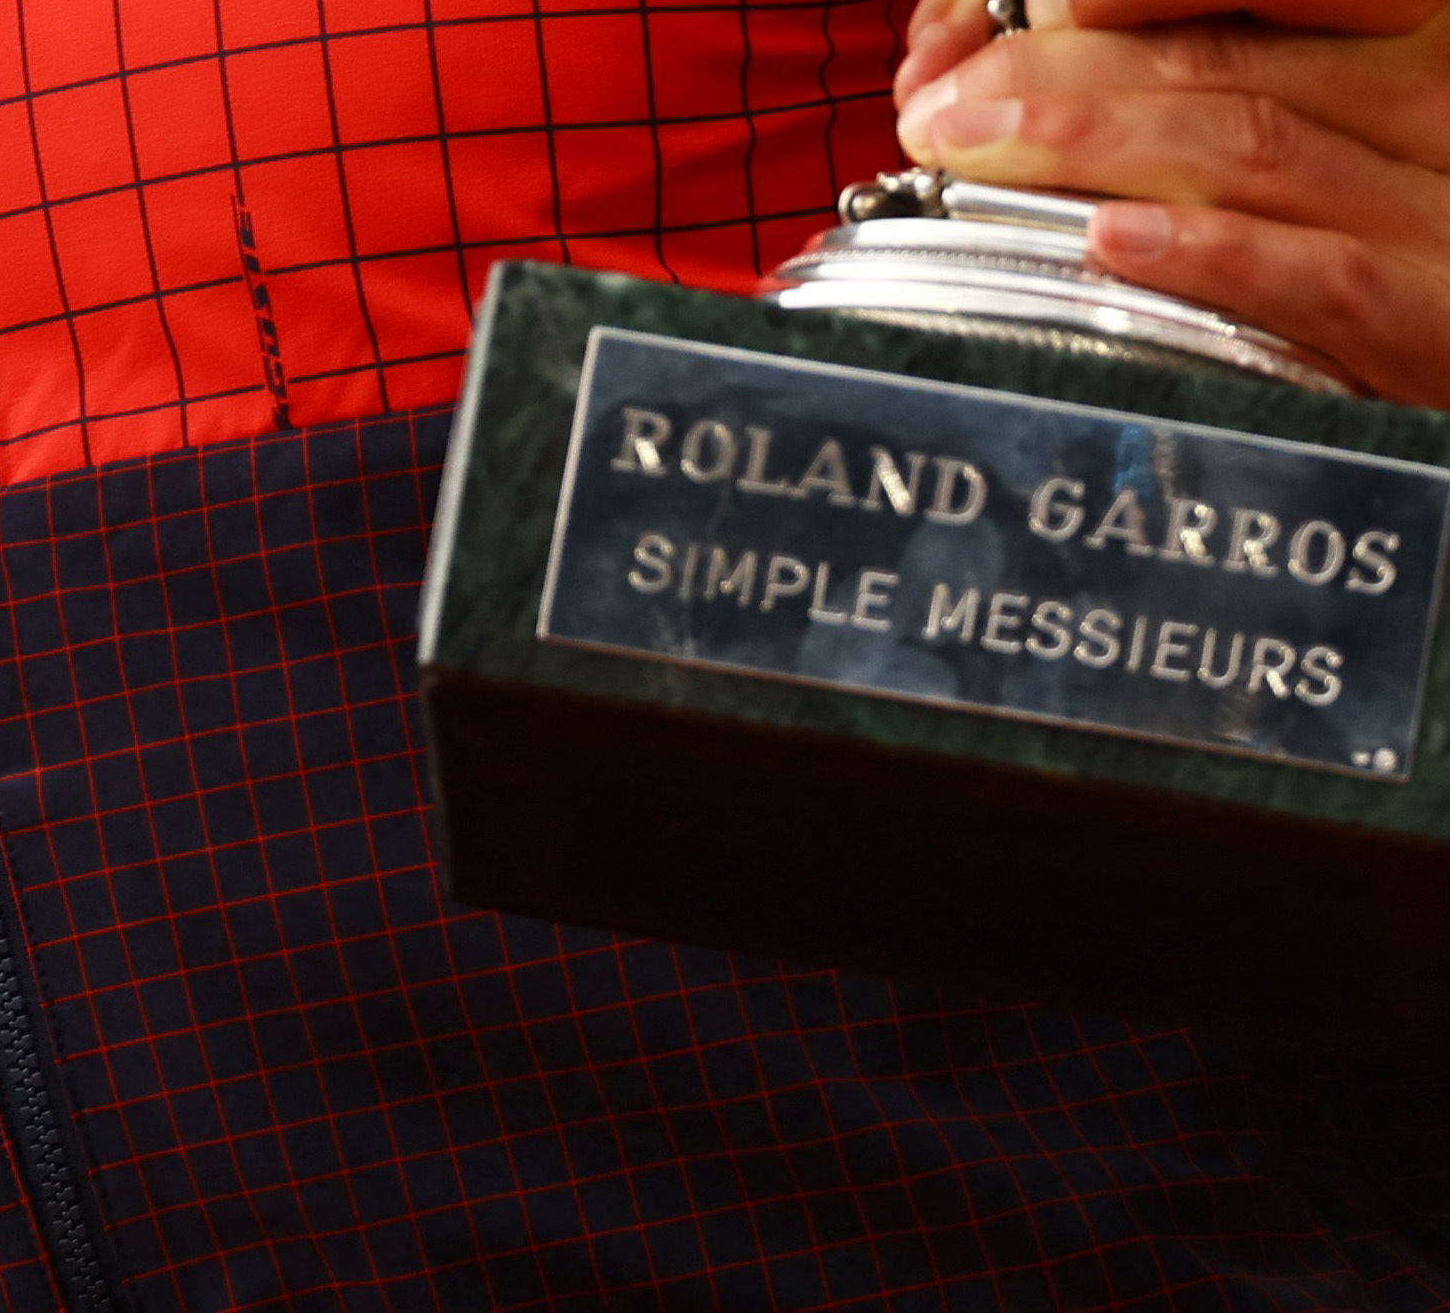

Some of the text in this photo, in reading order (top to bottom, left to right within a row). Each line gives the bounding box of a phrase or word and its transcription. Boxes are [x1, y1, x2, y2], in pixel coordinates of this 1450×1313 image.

[610, 405, 1400, 596] ROLAND GARROS
[627, 529, 1345, 708] SIMPLE MESSIEURS
